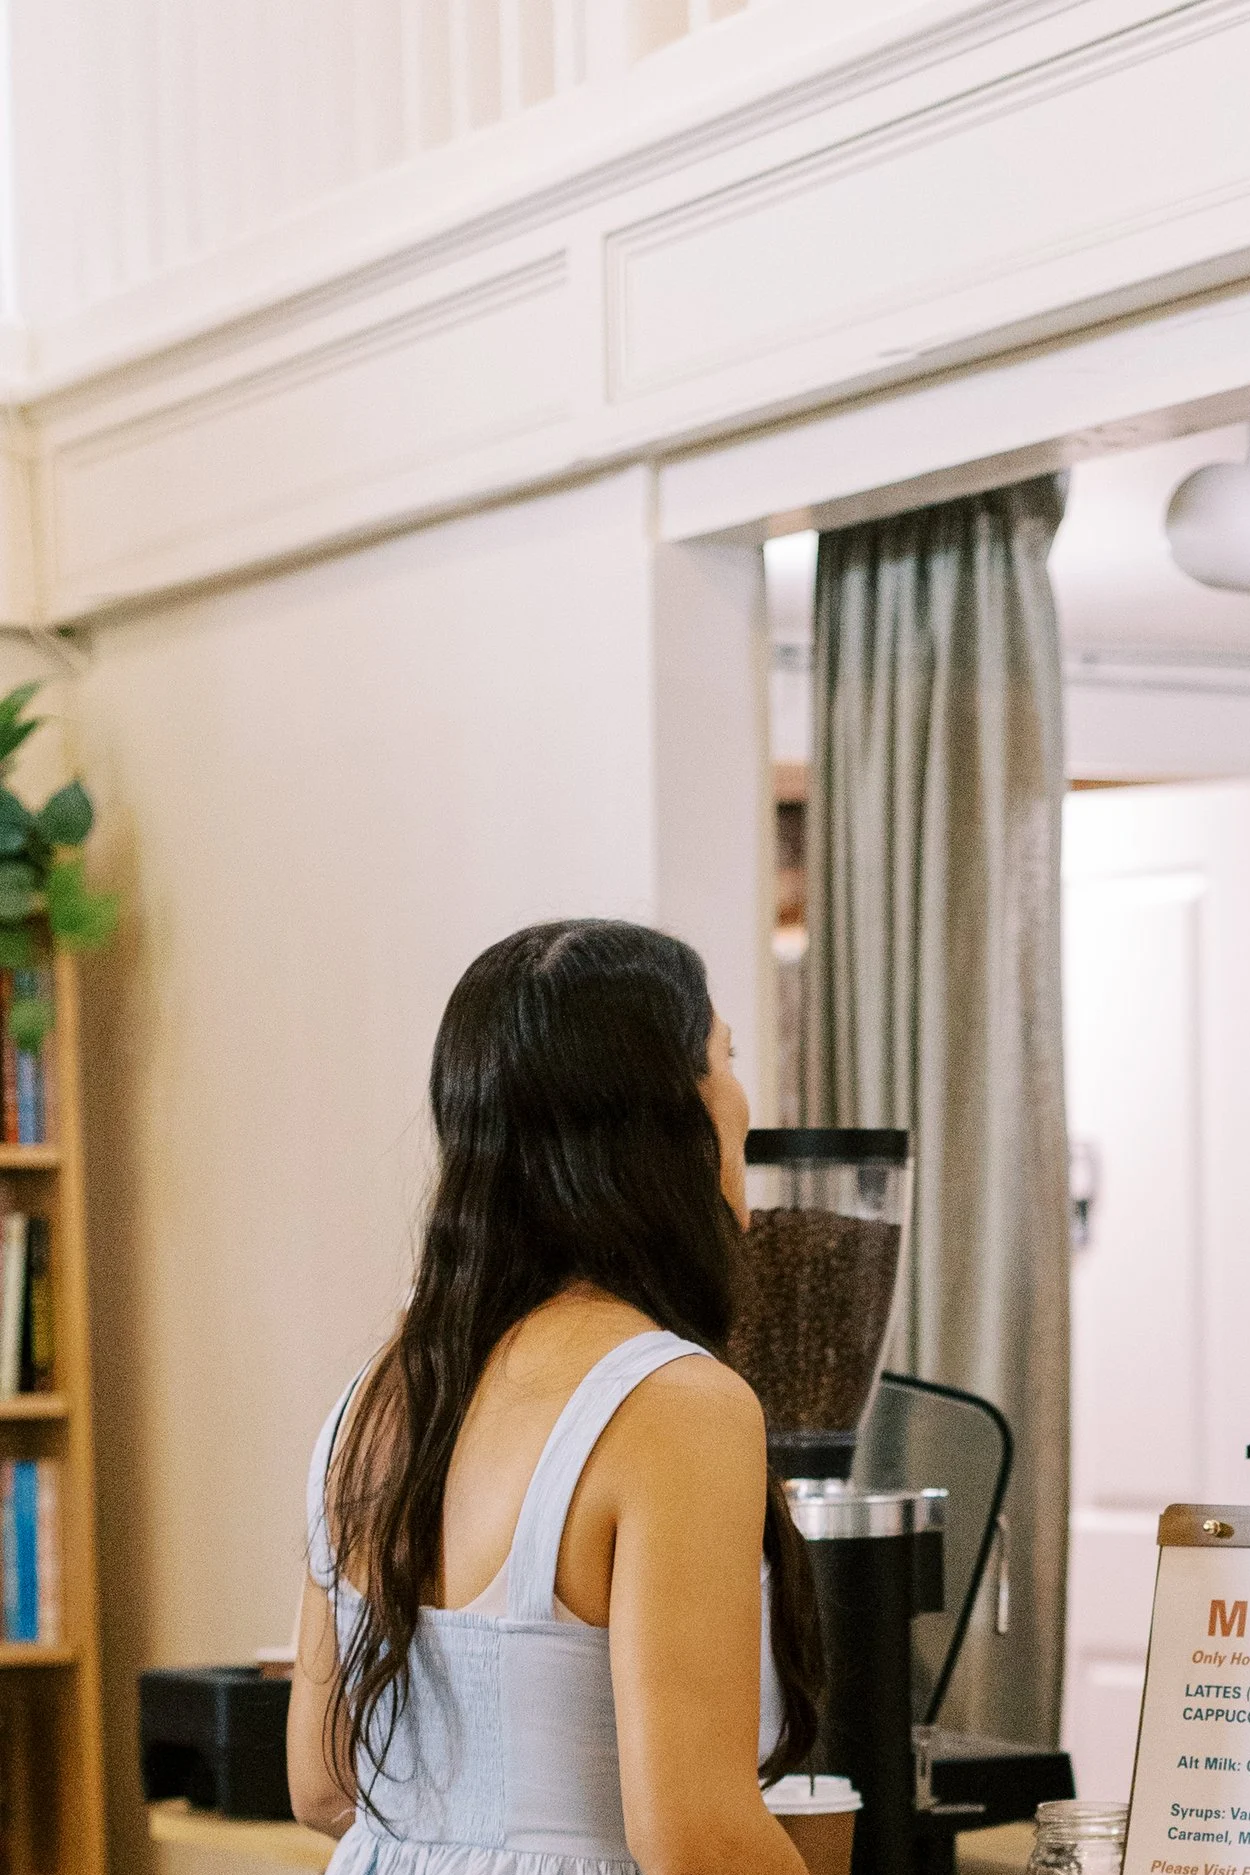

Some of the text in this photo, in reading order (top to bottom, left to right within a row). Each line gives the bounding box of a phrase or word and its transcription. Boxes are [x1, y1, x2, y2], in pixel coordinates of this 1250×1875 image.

[1191, 1650, 1226, 1668] Only
[1184, 1684, 1241, 1700] LATTES
[1177, 1755, 1200, 1769] Alt
[1204, 1757, 1242, 1772] Milk:
[1170, 1803, 1226, 1820] Syrups:
[1167, 1827, 1233, 1844] Caramel,
[1150, 1860, 1199, 1875] Please
